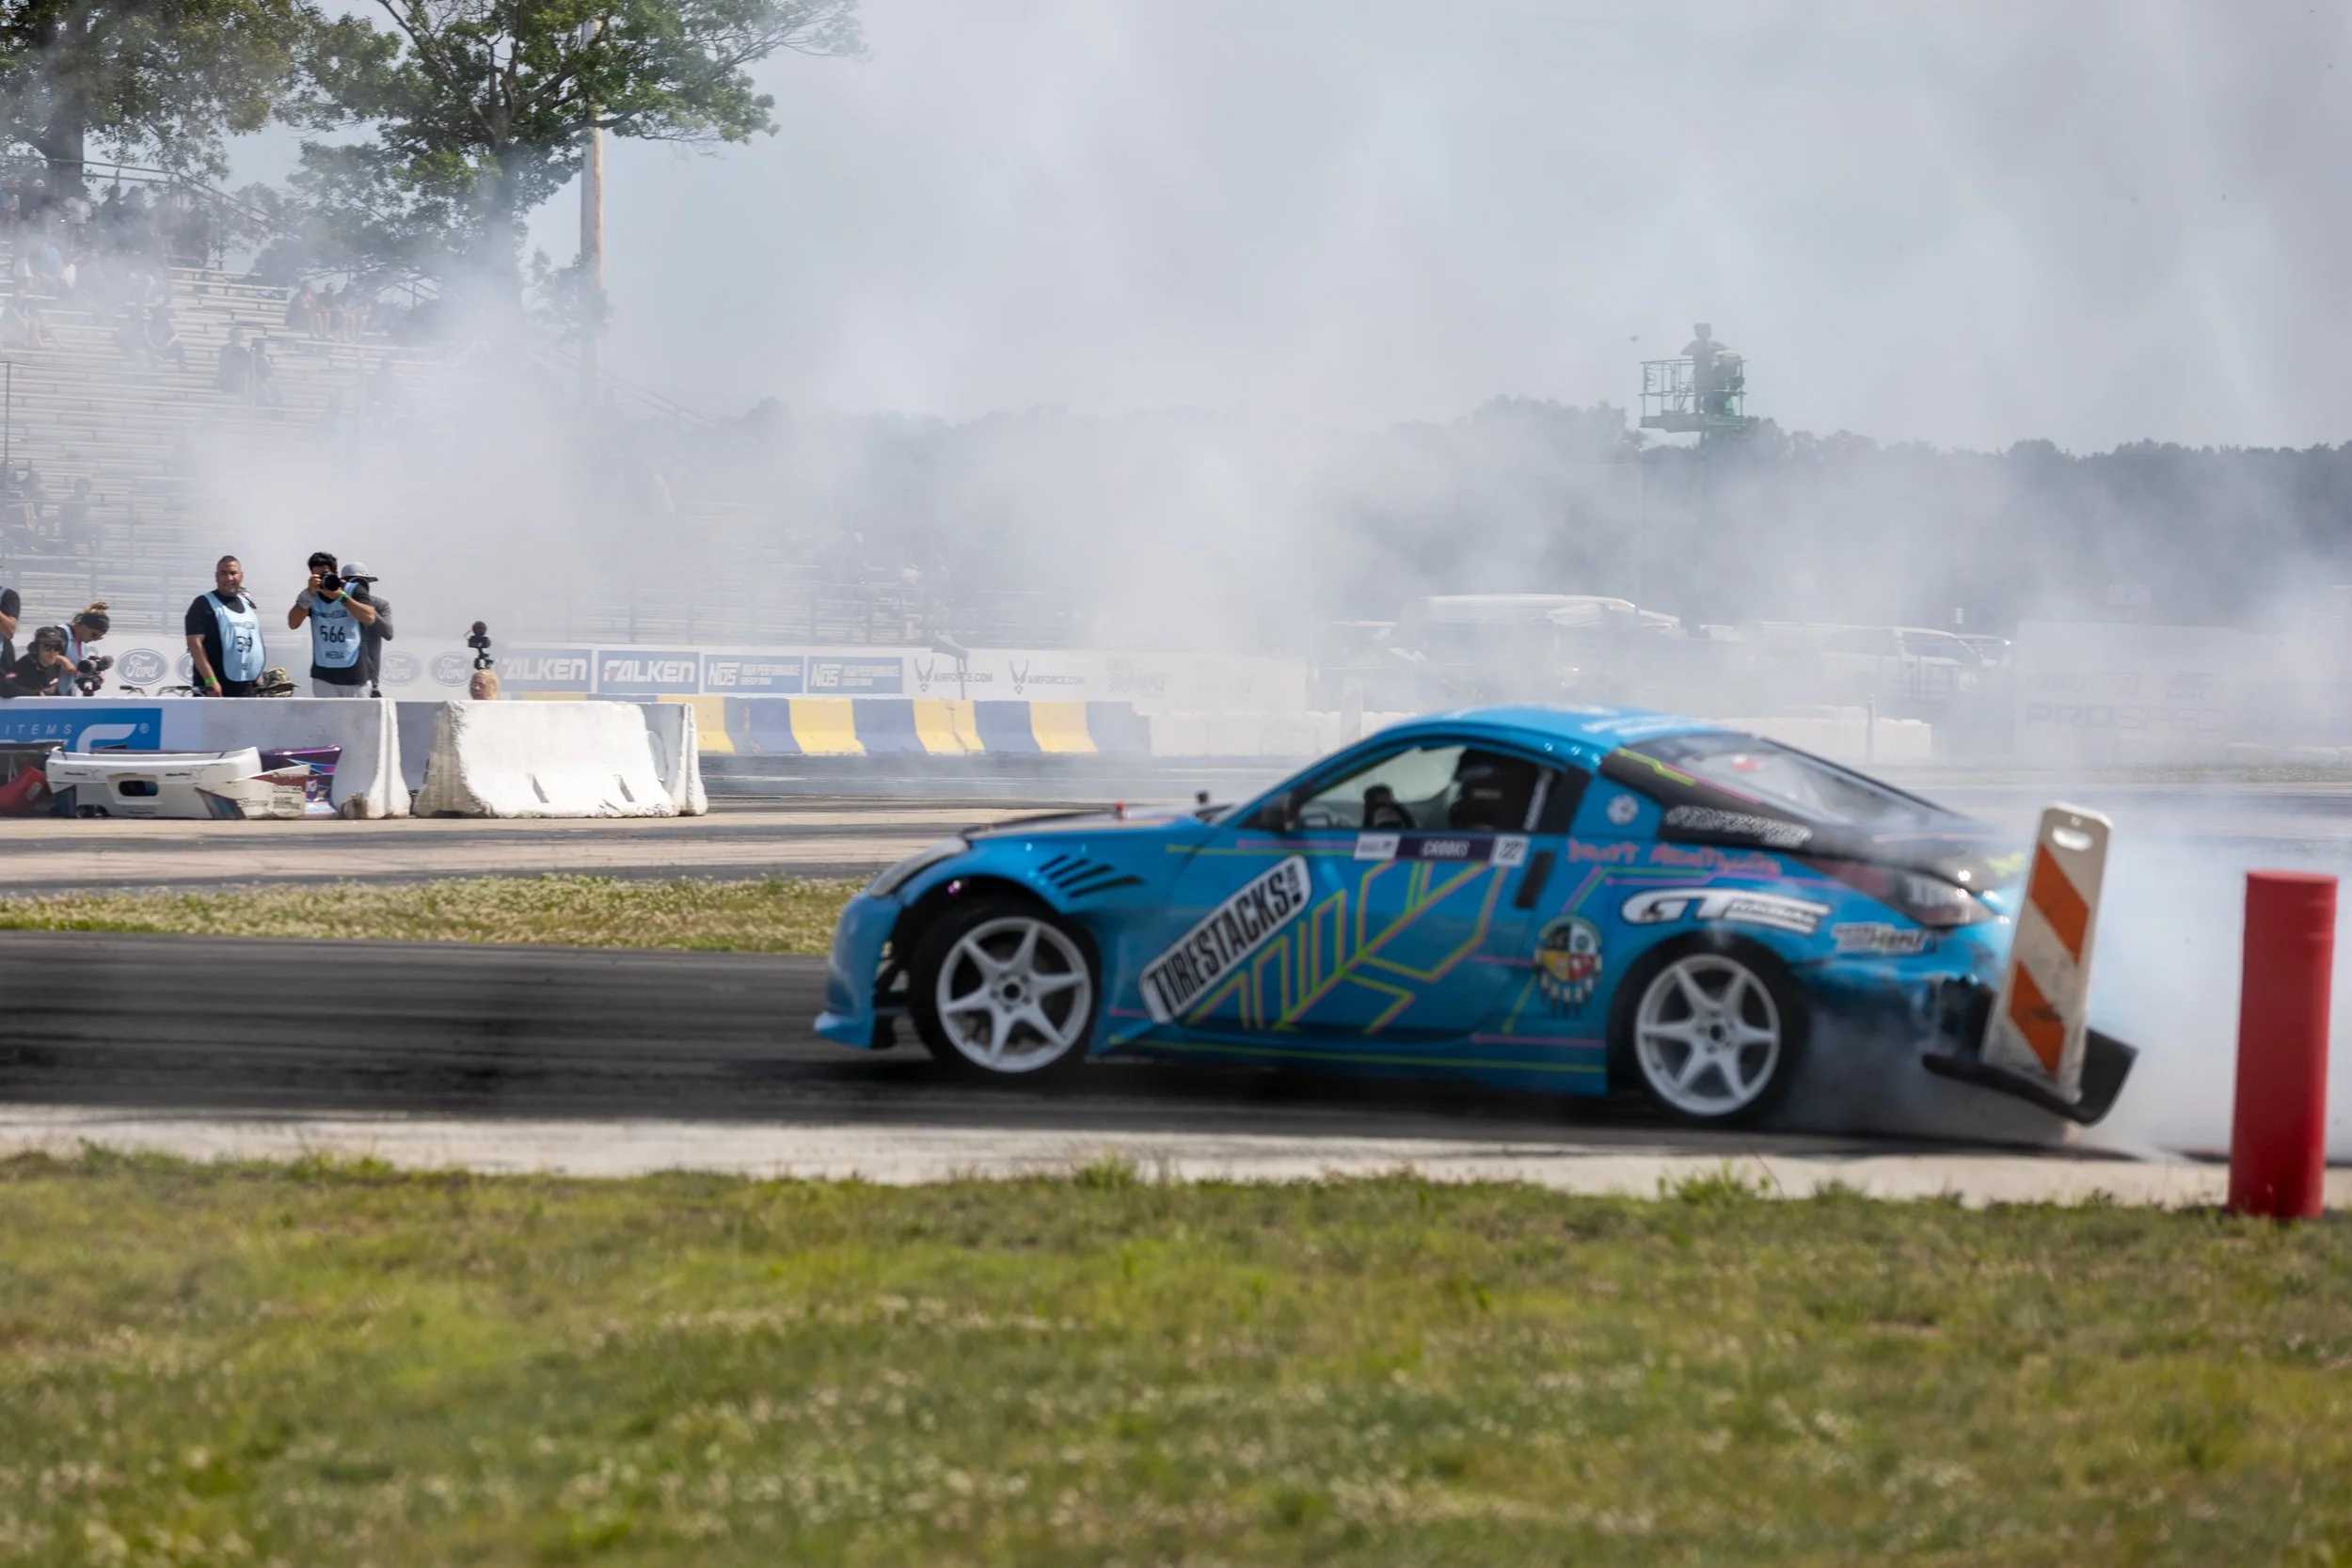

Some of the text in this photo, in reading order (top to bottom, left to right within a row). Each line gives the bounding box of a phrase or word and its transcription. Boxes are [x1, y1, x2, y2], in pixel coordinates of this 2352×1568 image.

[320, 626, 345, 642] 566
[125, 654, 159, 678] Ford
[385, 657, 410, 679] Ford
[438, 657, 468, 679] Ford
[603, 659, 695, 683] FALKEN
[707, 661, 740, 687] NOS
[810, 663, 842, 688] NOS
[1027, 674, 1086, 686] AIRFORCE.COM
[2025, 702, 2225, 733] PROSPEC
